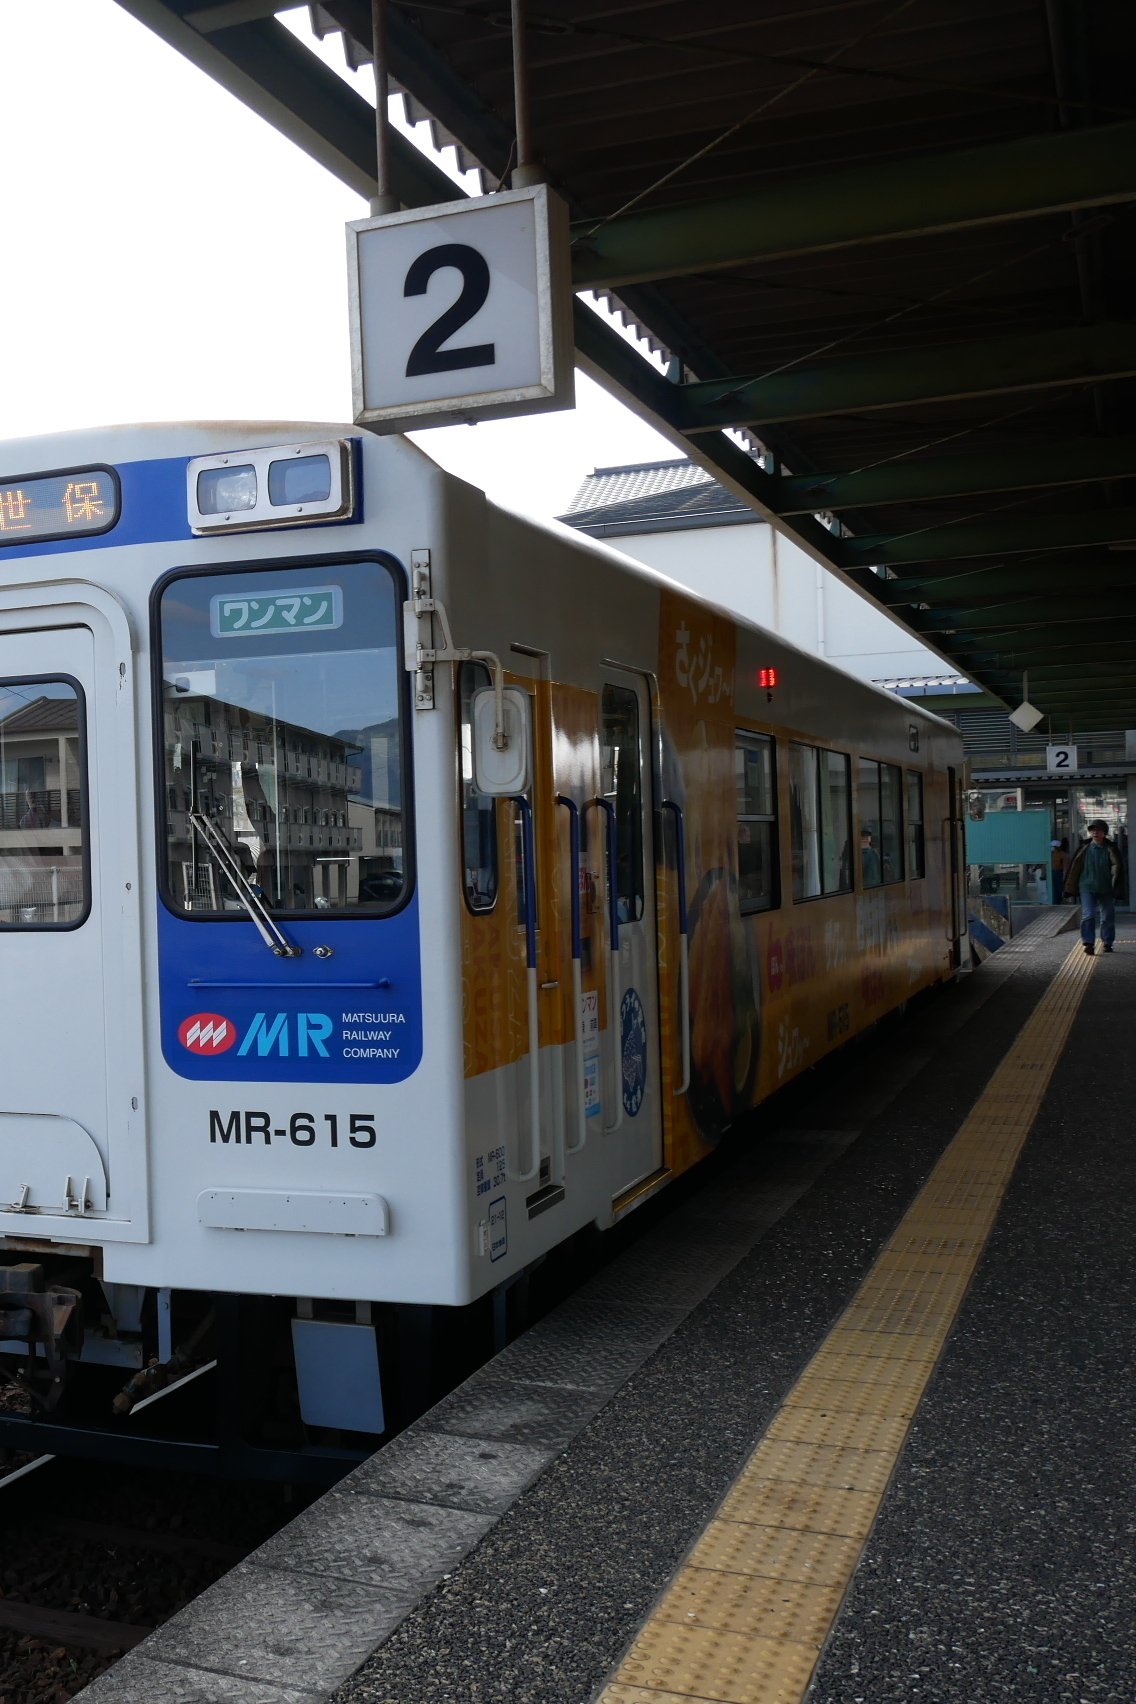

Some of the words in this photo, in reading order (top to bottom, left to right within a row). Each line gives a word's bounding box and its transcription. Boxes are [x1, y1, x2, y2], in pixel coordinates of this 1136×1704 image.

[403, 243, 496, 377] 2
[223, 596, 328, 629] ワンマン
[1055, 751, 1070, 768] 2
[342, 1012, 406, 1024] MATSUURA
[236, 1012, 333, 1057] MR
[342, 1030, 392, 1041] RAILWAY
[343, 1048, 400, 1059] COMPANY
[209, 1110, 377, 1149] MR-615
